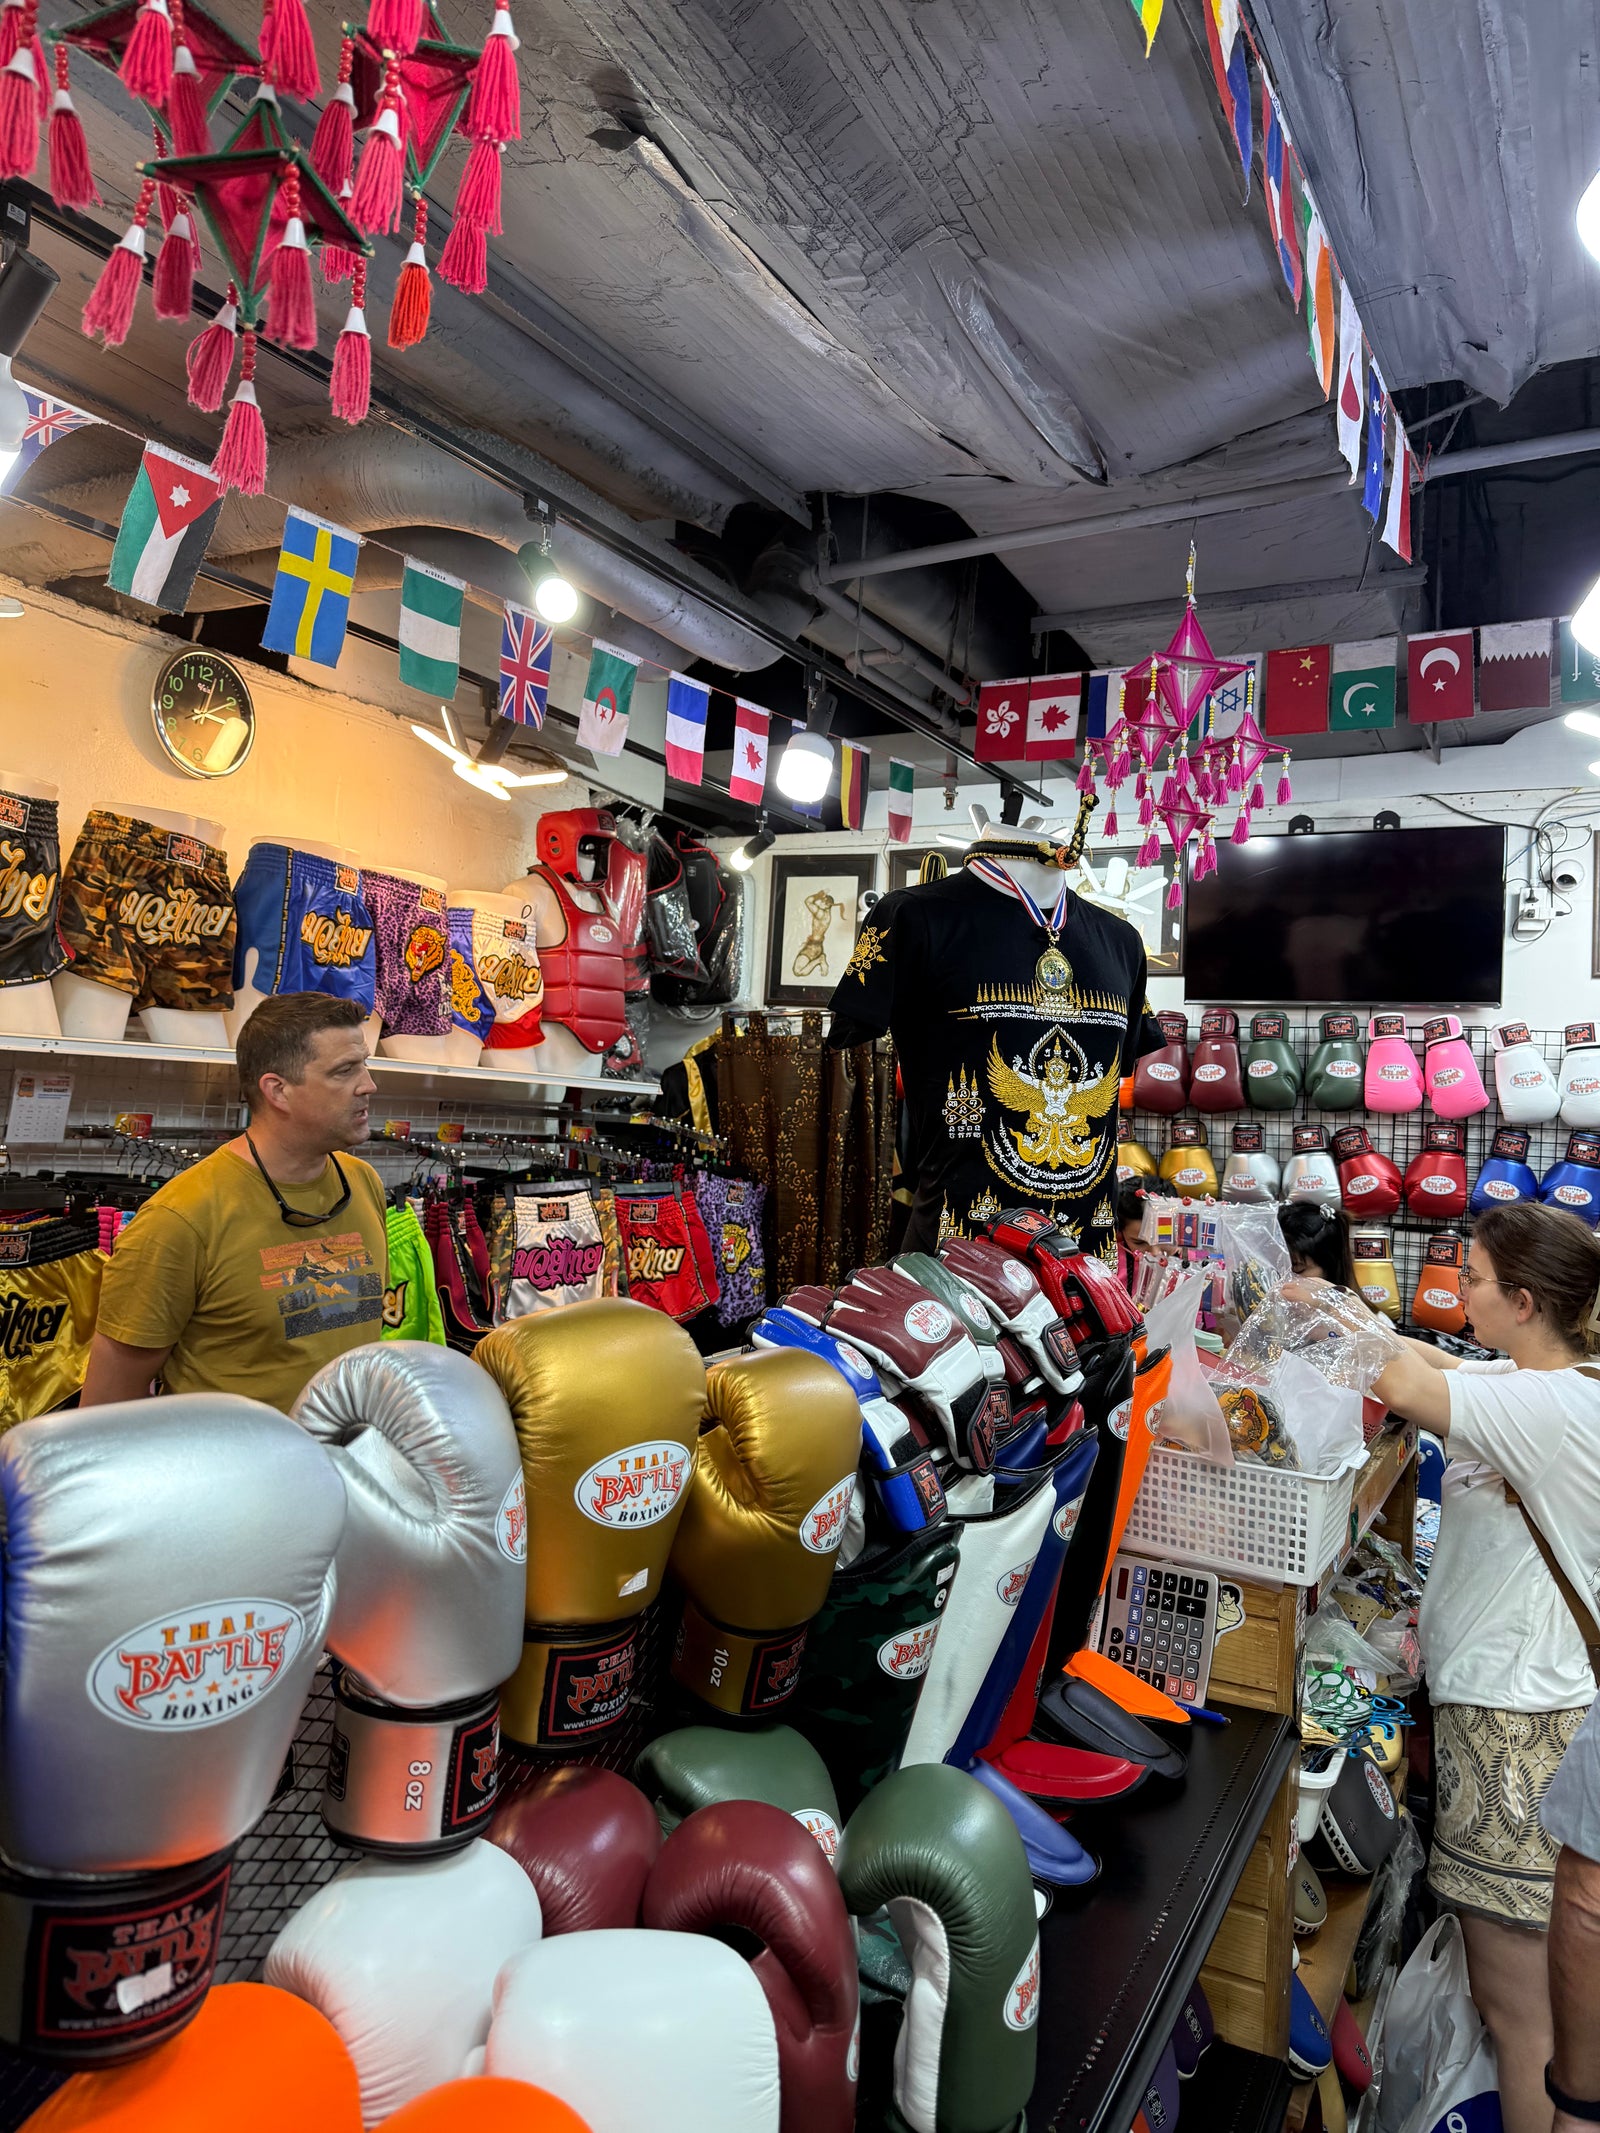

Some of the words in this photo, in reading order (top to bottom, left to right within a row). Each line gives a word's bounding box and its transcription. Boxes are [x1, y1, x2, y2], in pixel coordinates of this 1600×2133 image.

[184, 663, 195, 680] 11
[199, 665, 213, 682] 12
[169, 675, 183, 692] 10
[219, 679, 224, 692] 1
[162, 695, 174, 709] 9
[166, 717, 176, 731] 8
[177, 737, 186, 751] 7
[193, 748, 203, 761] 6
[512, 1235, 603, 1289] มวยไทย
[628, 1234, 685, 1281] ยไทย
[618, 1451, 669, 1472] THAI
[592, 1455, 686, 1520] BATTLE
[618, 1501, 666, 1522] BOXING
[1137, 1570, 1143, 1580] M+
[1132, 1609, 1139, 1621] MR
[161, 1611, 256, 1646] THAI
[1129, 1630, 1136, 1640] MC
[714, 1648, 729, 1667] 10
[1126, 1650, 1132, 1661] MU
[116, 1618, 294, 1719] BATTLE
[1170, 1681, 1177, 1692] CE
[1186, 1685, 1193, 1696] AC
[161, 1685, 254, 1721] BOXING
[408, 1760, 432, 1777] 8
[113, 1904, 194, 1945] THAI
[63, 1904, 218, 2011] BATTLE
